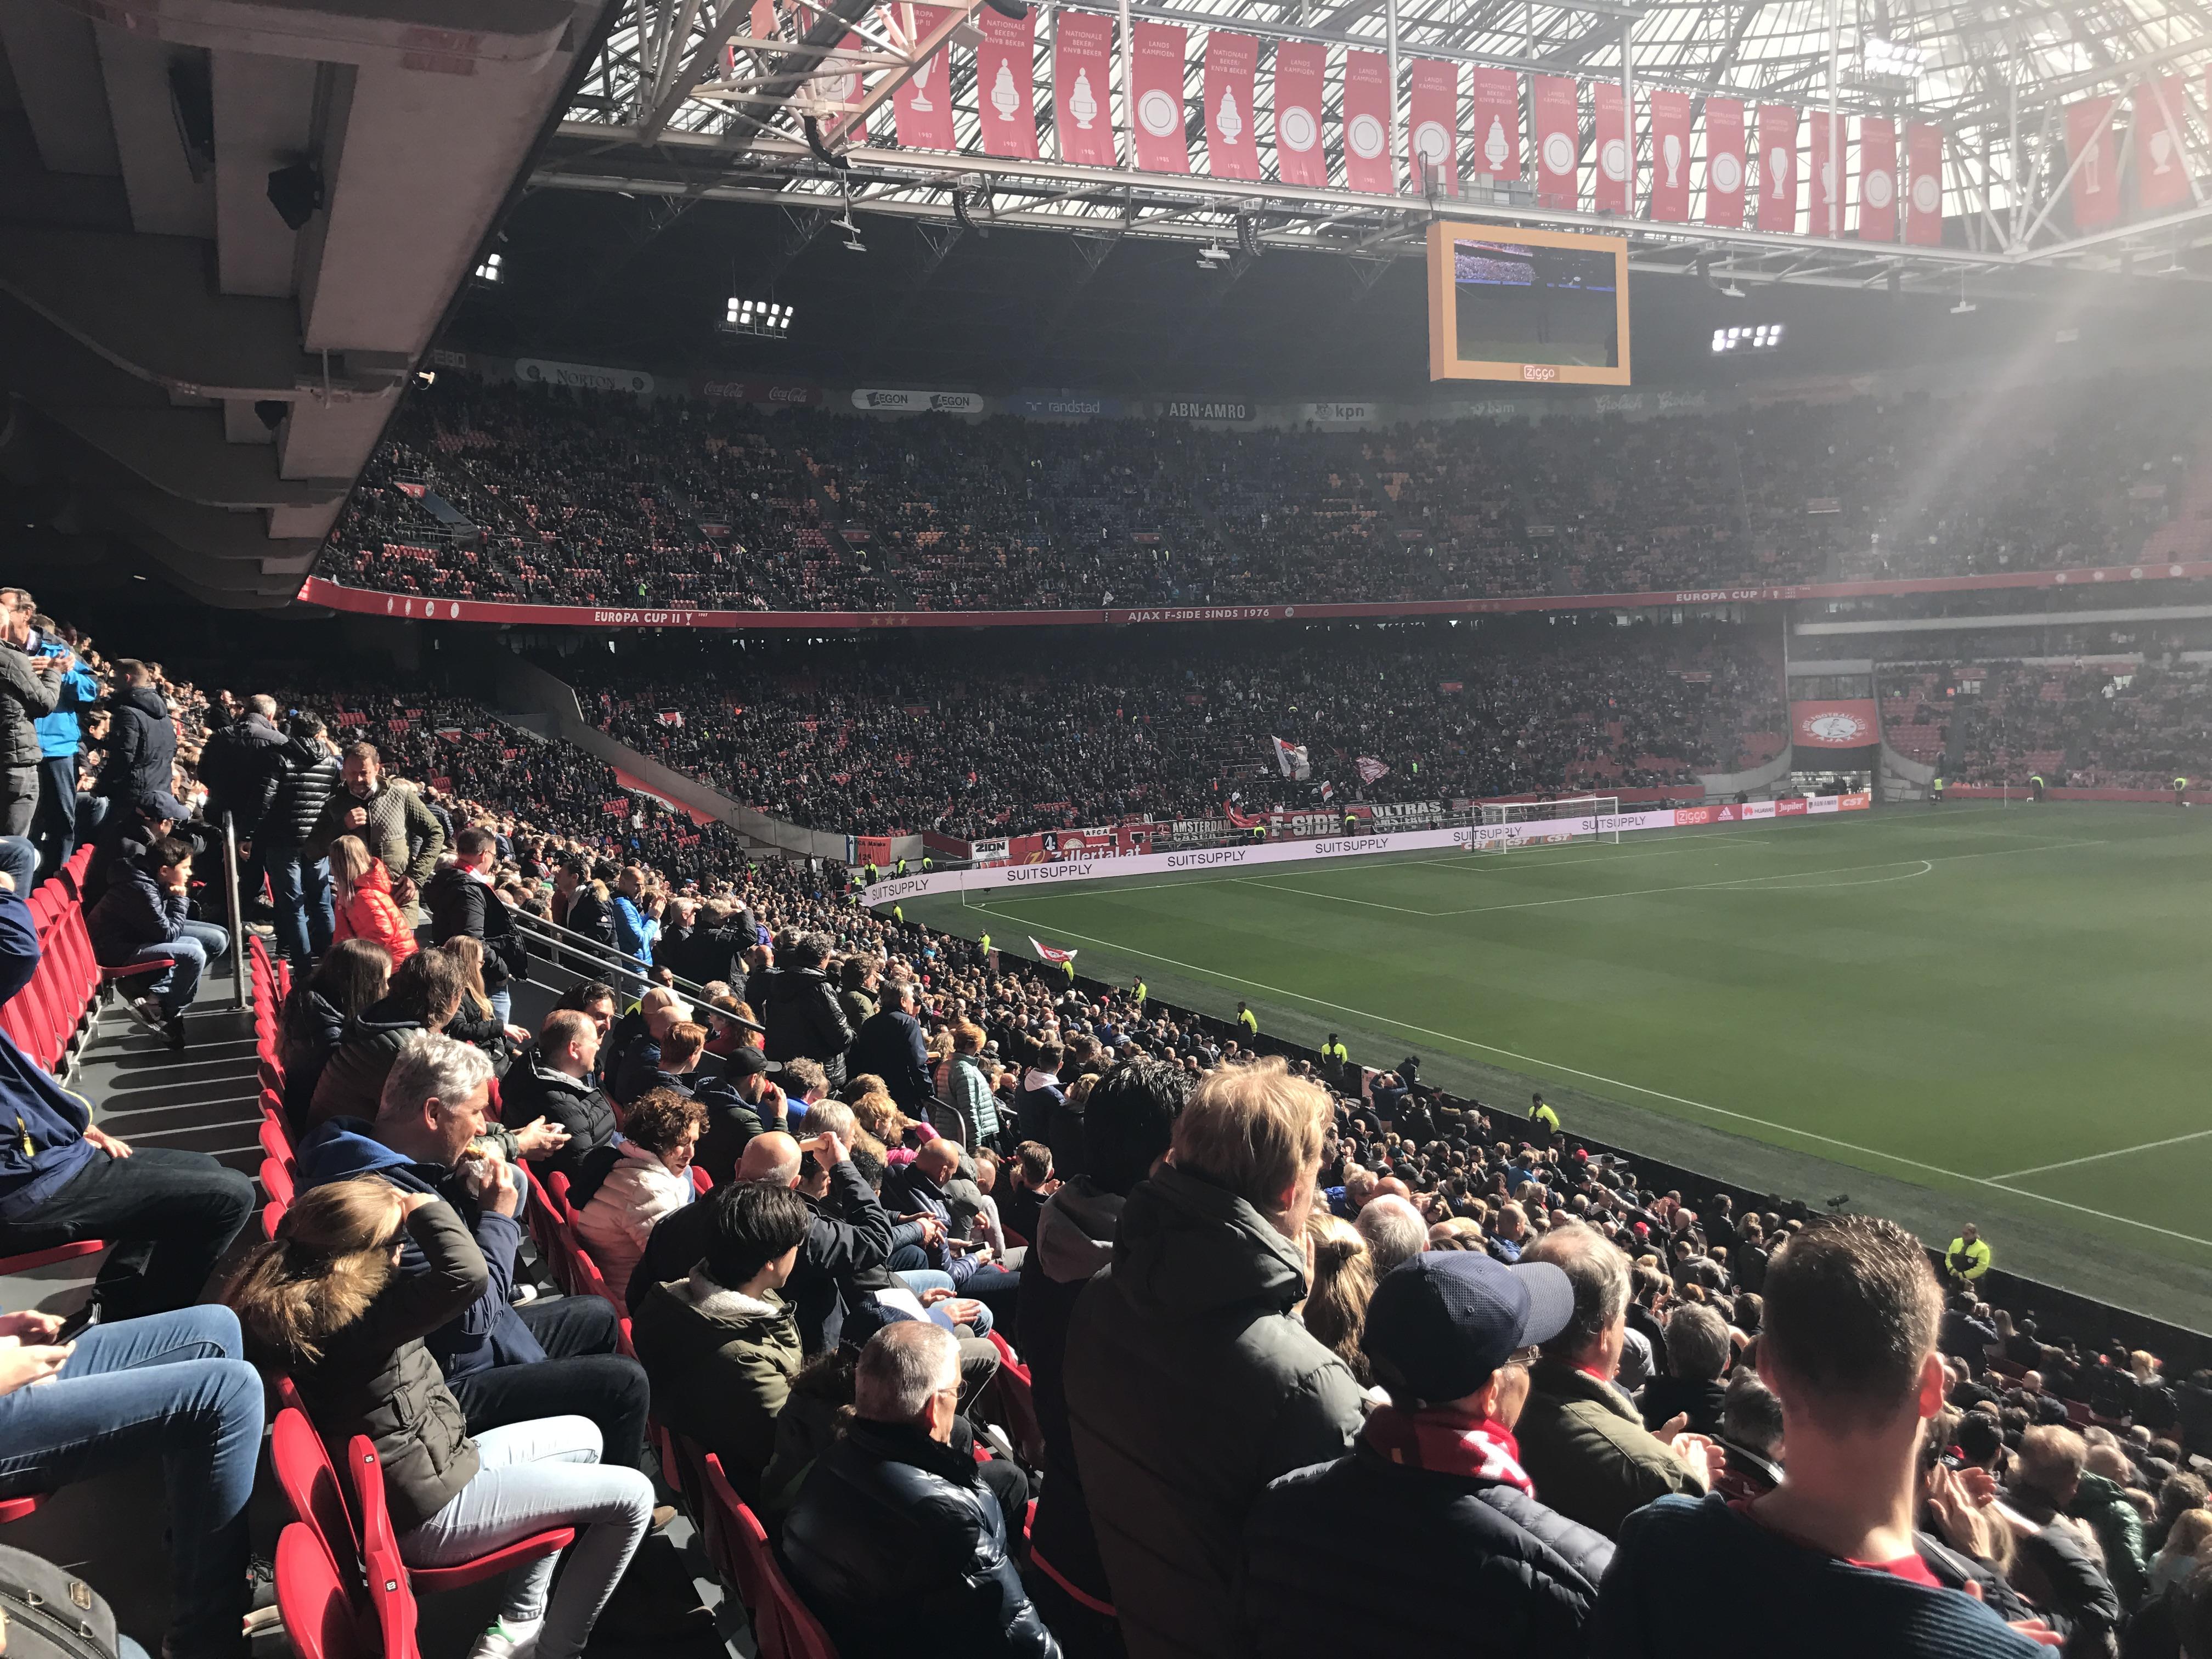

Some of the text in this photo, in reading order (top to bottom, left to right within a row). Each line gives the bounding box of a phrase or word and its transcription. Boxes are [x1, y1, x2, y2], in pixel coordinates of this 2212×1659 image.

[913, 9, 934, 18] ROPA
[986, 19, 1026, 31] NATIONALE
[994, 29, 1018, 38] BEKER/
[1065, 30, 1102, 41] NATIONALE
[985, 37, 1025, 48] KNVB BEKER
[1072, 39, 1094, 47] BEKER/
[1148, 41, 1170, 49] LANDS
[1063, 46, 1102, 57] KNVB BEKER
[1142, 48, 1175, 58] KAMPIOEN
[1213, 49, 1248, 59] NATIONALE
[1290, 59, 1311, 67] LANDS
[1211, 65, 1247, 75] KNVB BEKER
[1284, 66, 1315, 75] KAMPIOEN
[1352, 75, 1383, 84] KAMPIOEN
[557, 369, 615, 387] NORTON
[872, 393, 909, 404] AEGON
[934, 396, 970, 407] AEGON
[1048, 399, 1101, 414] randstad
[1335, 404, 1365, 420] kpn
[1676, 592, 1726, 602] EUROPA
[1731, 590, 1758, 599] CUP
[595, 611, 639, 623] EUROPA
[644, 613, 668, 623] CUP
[672, 613, 680, 623] II
[1128, 608, 1269, 622] AJAX F-SIDE SINDS 1976
[1779, 802, 1804, 812] Jupiler
[1842, 798, 1864, 806] CST
[1372, 801, 1441, 818] ULTRAS
[1172, 819, 1231, 833] AMSTERDAM
[1269, 814, 1341, 837] F-SIDE
[1547, 833, 1570, 843] CST
[975, 842, 1006, 853] ZION
[1316, 838, 1389, 854] SUITSUPPLY
[1167, 851, 1246, 867] SUITSUPPLY
[1007, 864, 1093, 882] SUITSUPPLY
[872, 879, 929, 901] SUITSUPPLY
